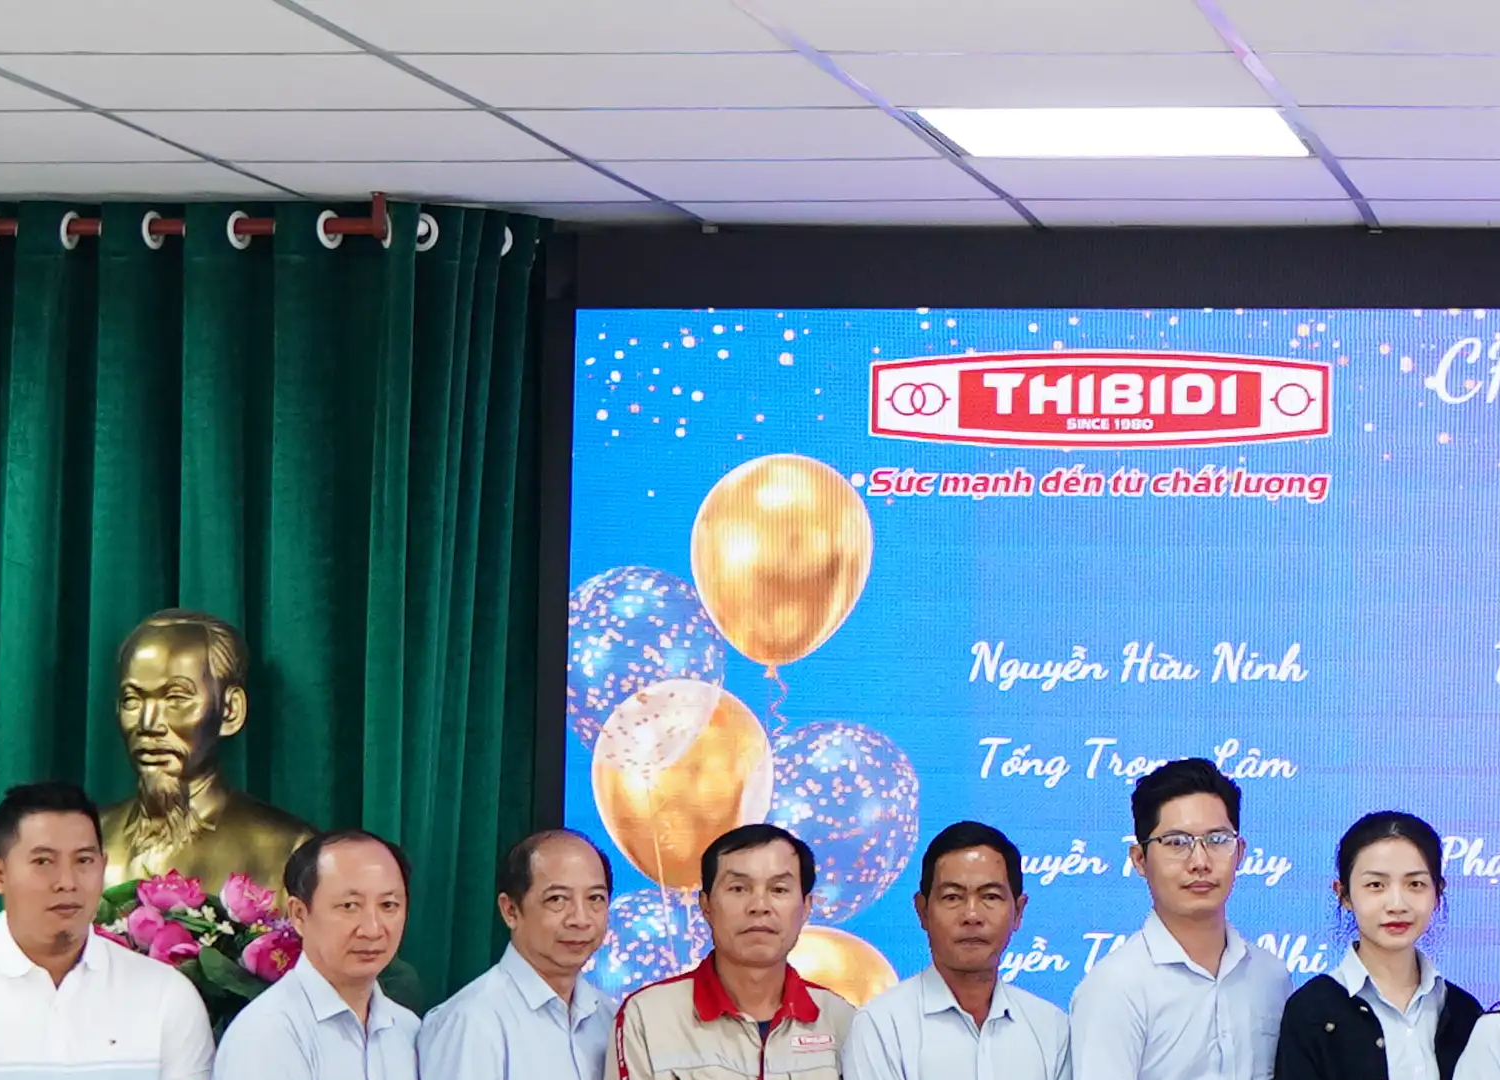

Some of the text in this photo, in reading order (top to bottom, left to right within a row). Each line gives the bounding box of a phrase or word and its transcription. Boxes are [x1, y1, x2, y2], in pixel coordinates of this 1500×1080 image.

[983, 373, 1237, 414] THIBIDI
[1066, 418, 1153, 431] SINCE 1980
[870, 468, 934, 494] Sức
[941, 471, 1033, 498] mạnh
[1041, 465, 1102, 494] đến
[1232, 470, 1329, 501] lượng
[968, 640, 1110, 692] Nguyễn
[1210, 641, 1309, 684] Ninh
[978, 737, 1071, 788] Tống
[1083, 736, 1170, 784] Trọn
[1020, 837, 1109, 887] uyễn
